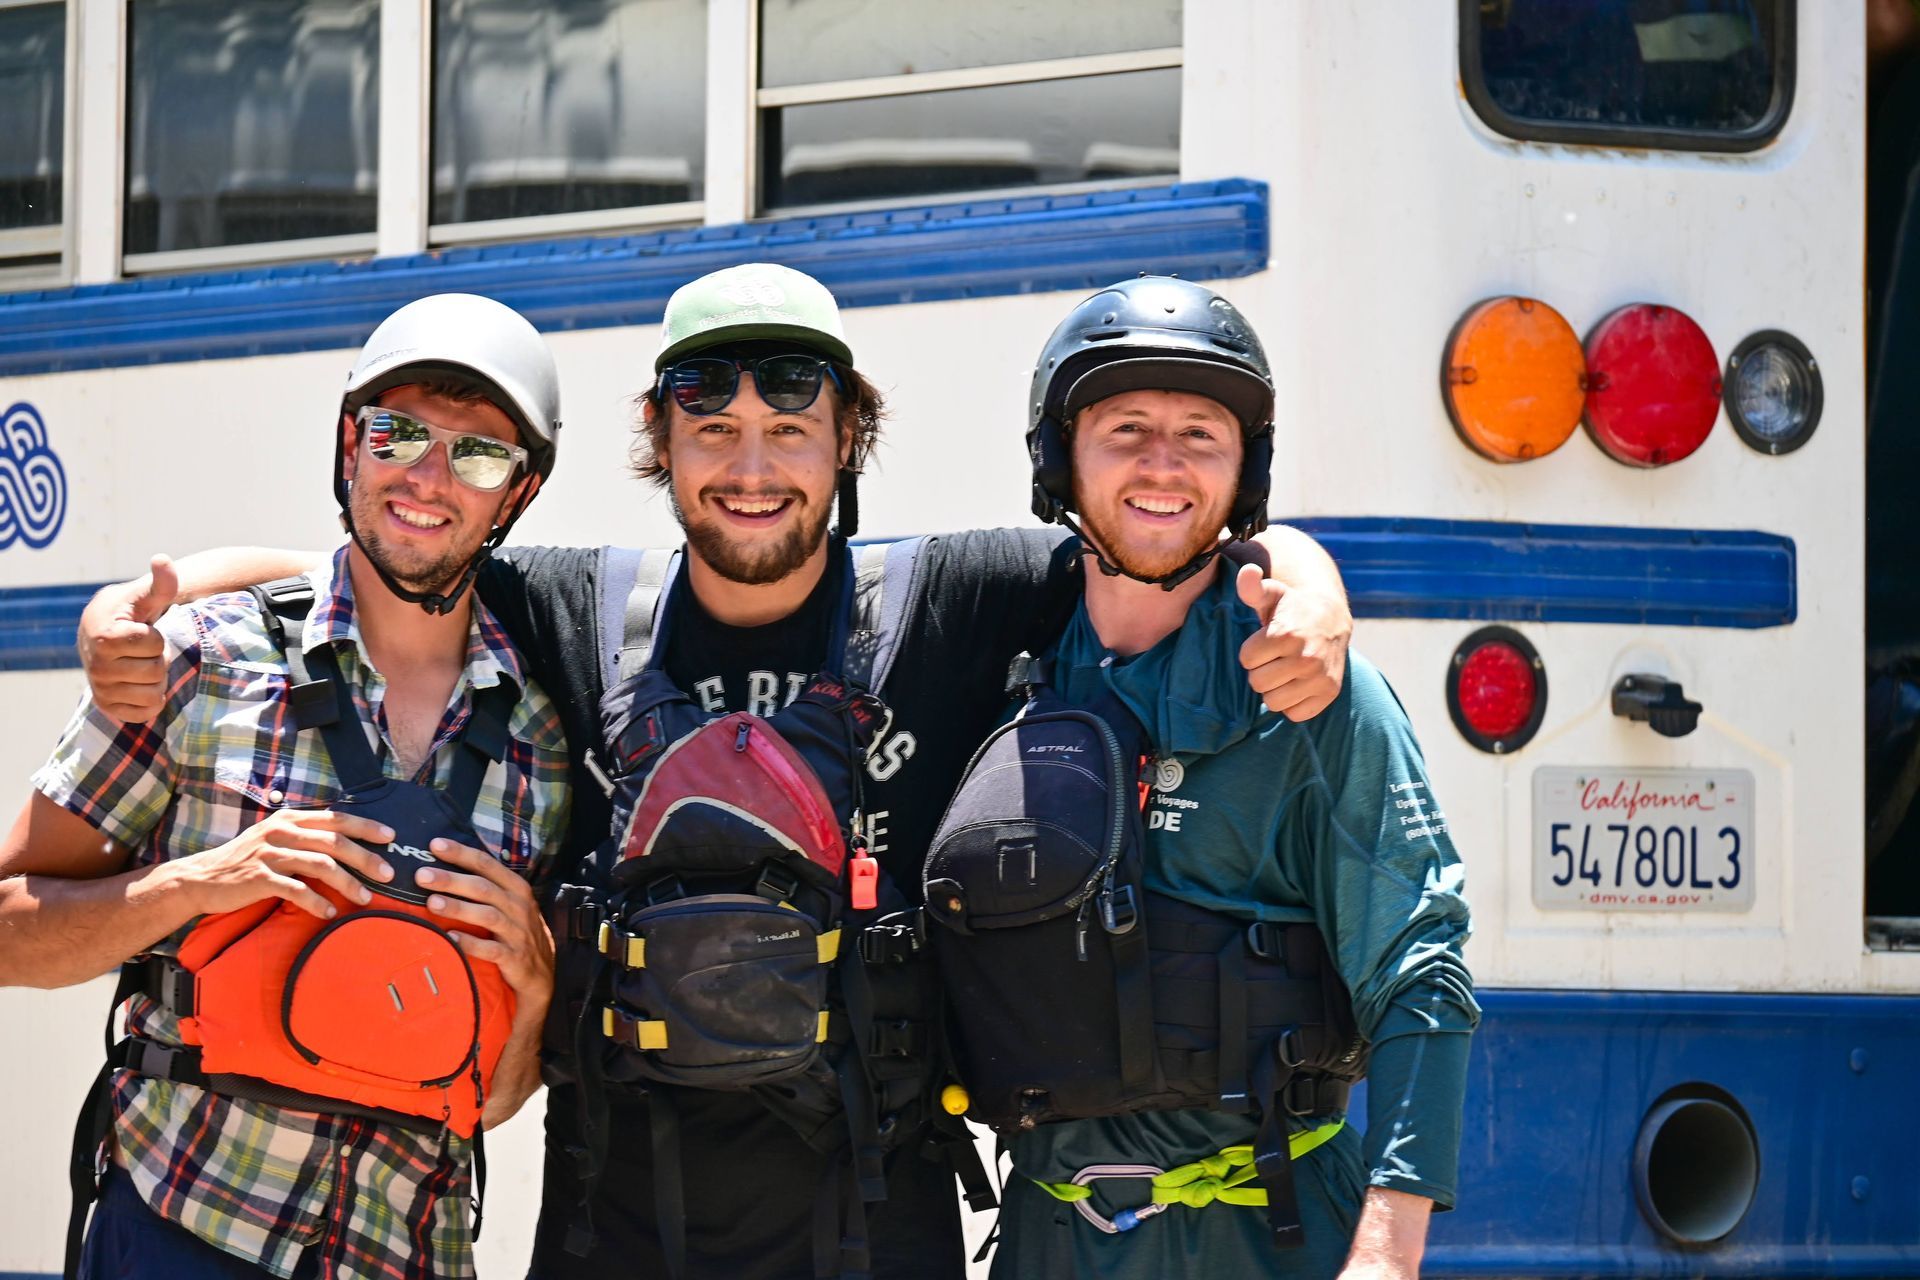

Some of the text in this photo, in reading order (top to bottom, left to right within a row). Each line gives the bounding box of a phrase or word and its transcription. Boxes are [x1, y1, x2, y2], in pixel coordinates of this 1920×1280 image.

[1026, 745, 1085, 753] ASTRAL
[1157, 794, 1199, 810] Voyages
[1580, 778, 1715, 820] California
[387, 842, 437, 863] NRS
[1551, 823, 1741, 890] 54780L3
[1589, 892, 1702, 905] dmv.ca.gov
